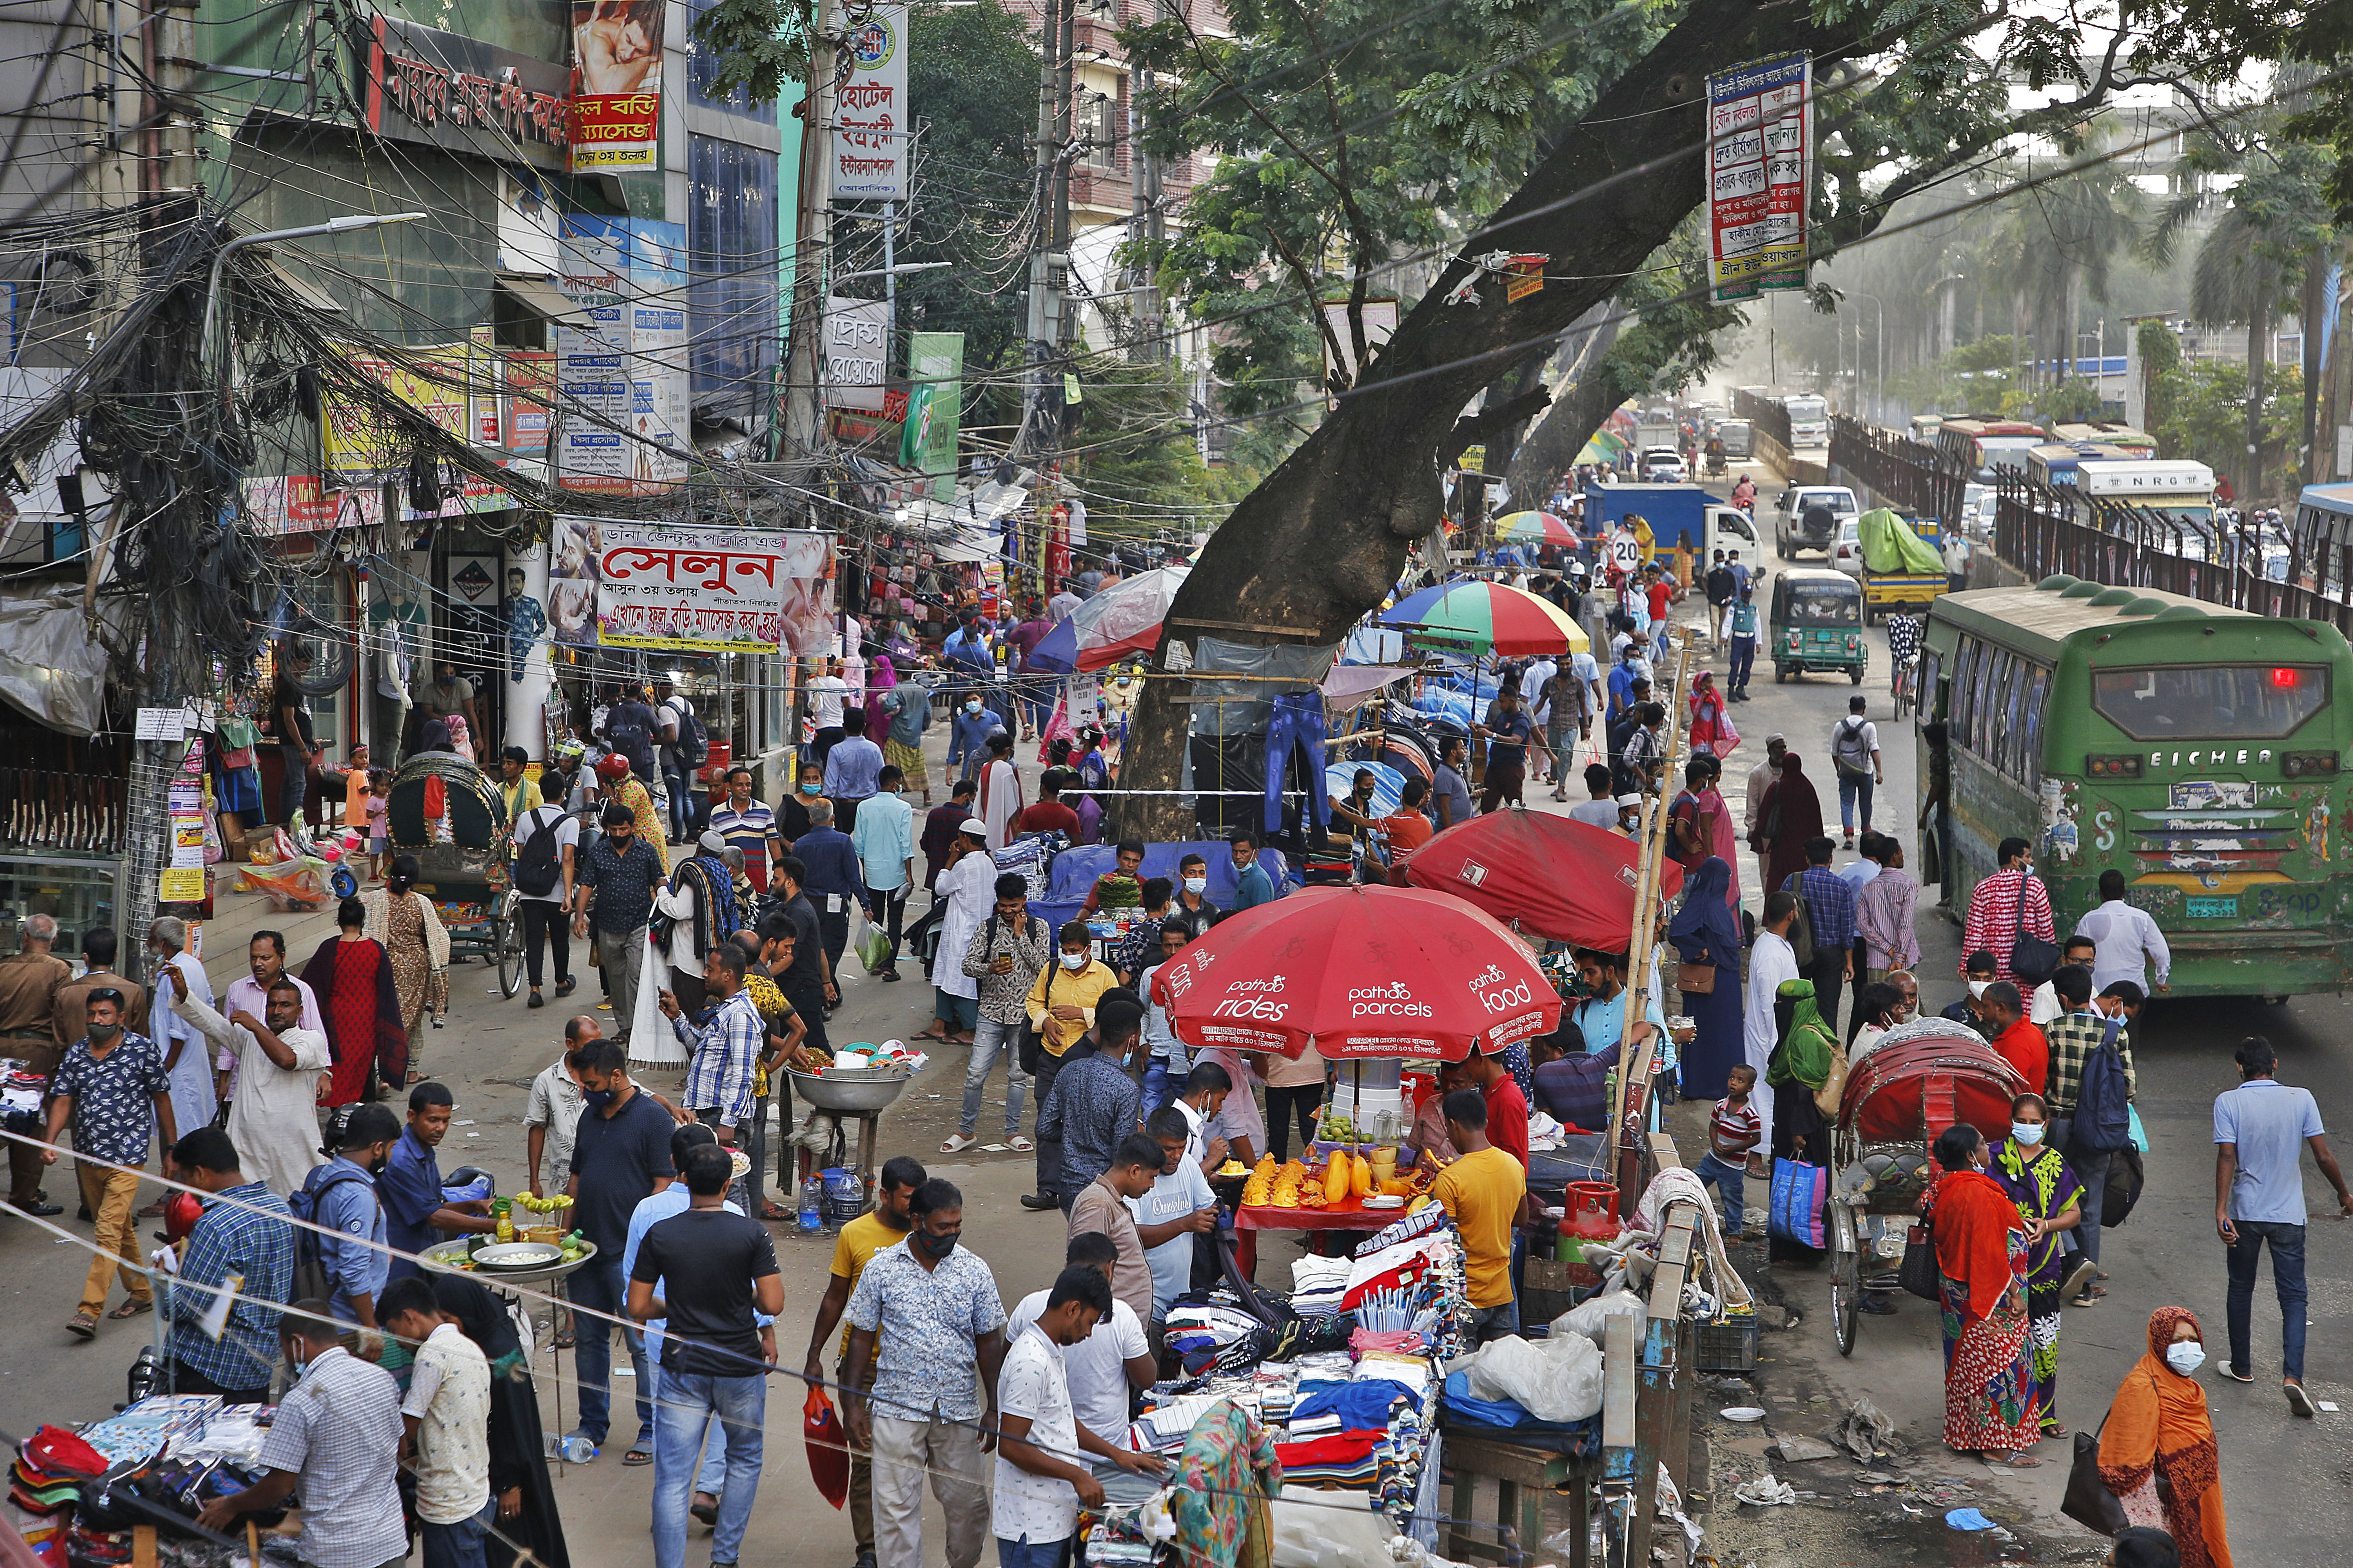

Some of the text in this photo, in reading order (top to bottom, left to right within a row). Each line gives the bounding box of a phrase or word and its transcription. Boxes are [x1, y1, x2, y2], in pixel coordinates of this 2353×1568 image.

[856, 59, 885, 68] ESIDENTIAL
[840, 78, 894, 112] হোটেল
[610, 94, 657, 115] বডি
[1714, 110, 1731, 130] যৌন
[581, 123, 651, 139] ম্যাসেজ
[598, 152, 615, 161] ৩য়
[619, 150, 648, 161] তলায়
[840, 153, 895, 177] ইন্টারন্যাশনাল
[1762, 249, 1801, 263] ওয়াখানা
[830, 312, 885, 350] প্রিন্স
[606, 529, 785, 549] ডানা জেন্টস্ পার্লার এন্ড
[1616, 542, 1636, 560] 20
[602, 546, 786, 596] সেলুন
[602, 583, 699, 598] আসুন ৩য় তলায়
[713, 597, 780, 609] শীতাতপ নিয়ন্ত্রিত
[609, 598, 780, 638] এখানে ফুল বডি ম্যাসেজ করা হয়
[2149, 749, 2271, 767] EICHER
[1191, 948, 1216, 971] pathao
[1169, 963, 1192, 998] cars
[1226, 979, 1285, 993] pathao
[1468, 969, 1506, 994] pathao
[1348, 985, 1411, 1002] pathao
[1479, 978, 1532, 1015] food
[1212, 992, 1289, 1022] rides
[1352, 1001, 1433, 1018] parcels
[1236, 1028, 1253, 1036] প্রোমো
[1253, 1030, 1266, 1038] কোড
[1411, 1037, 1435, 1047] ব্যবহারে
[1258, 1038, 1285, 1050] ডিসকাউন্ট
[1414, 1046, 1442, 1055] ডিসকাউন্ট
